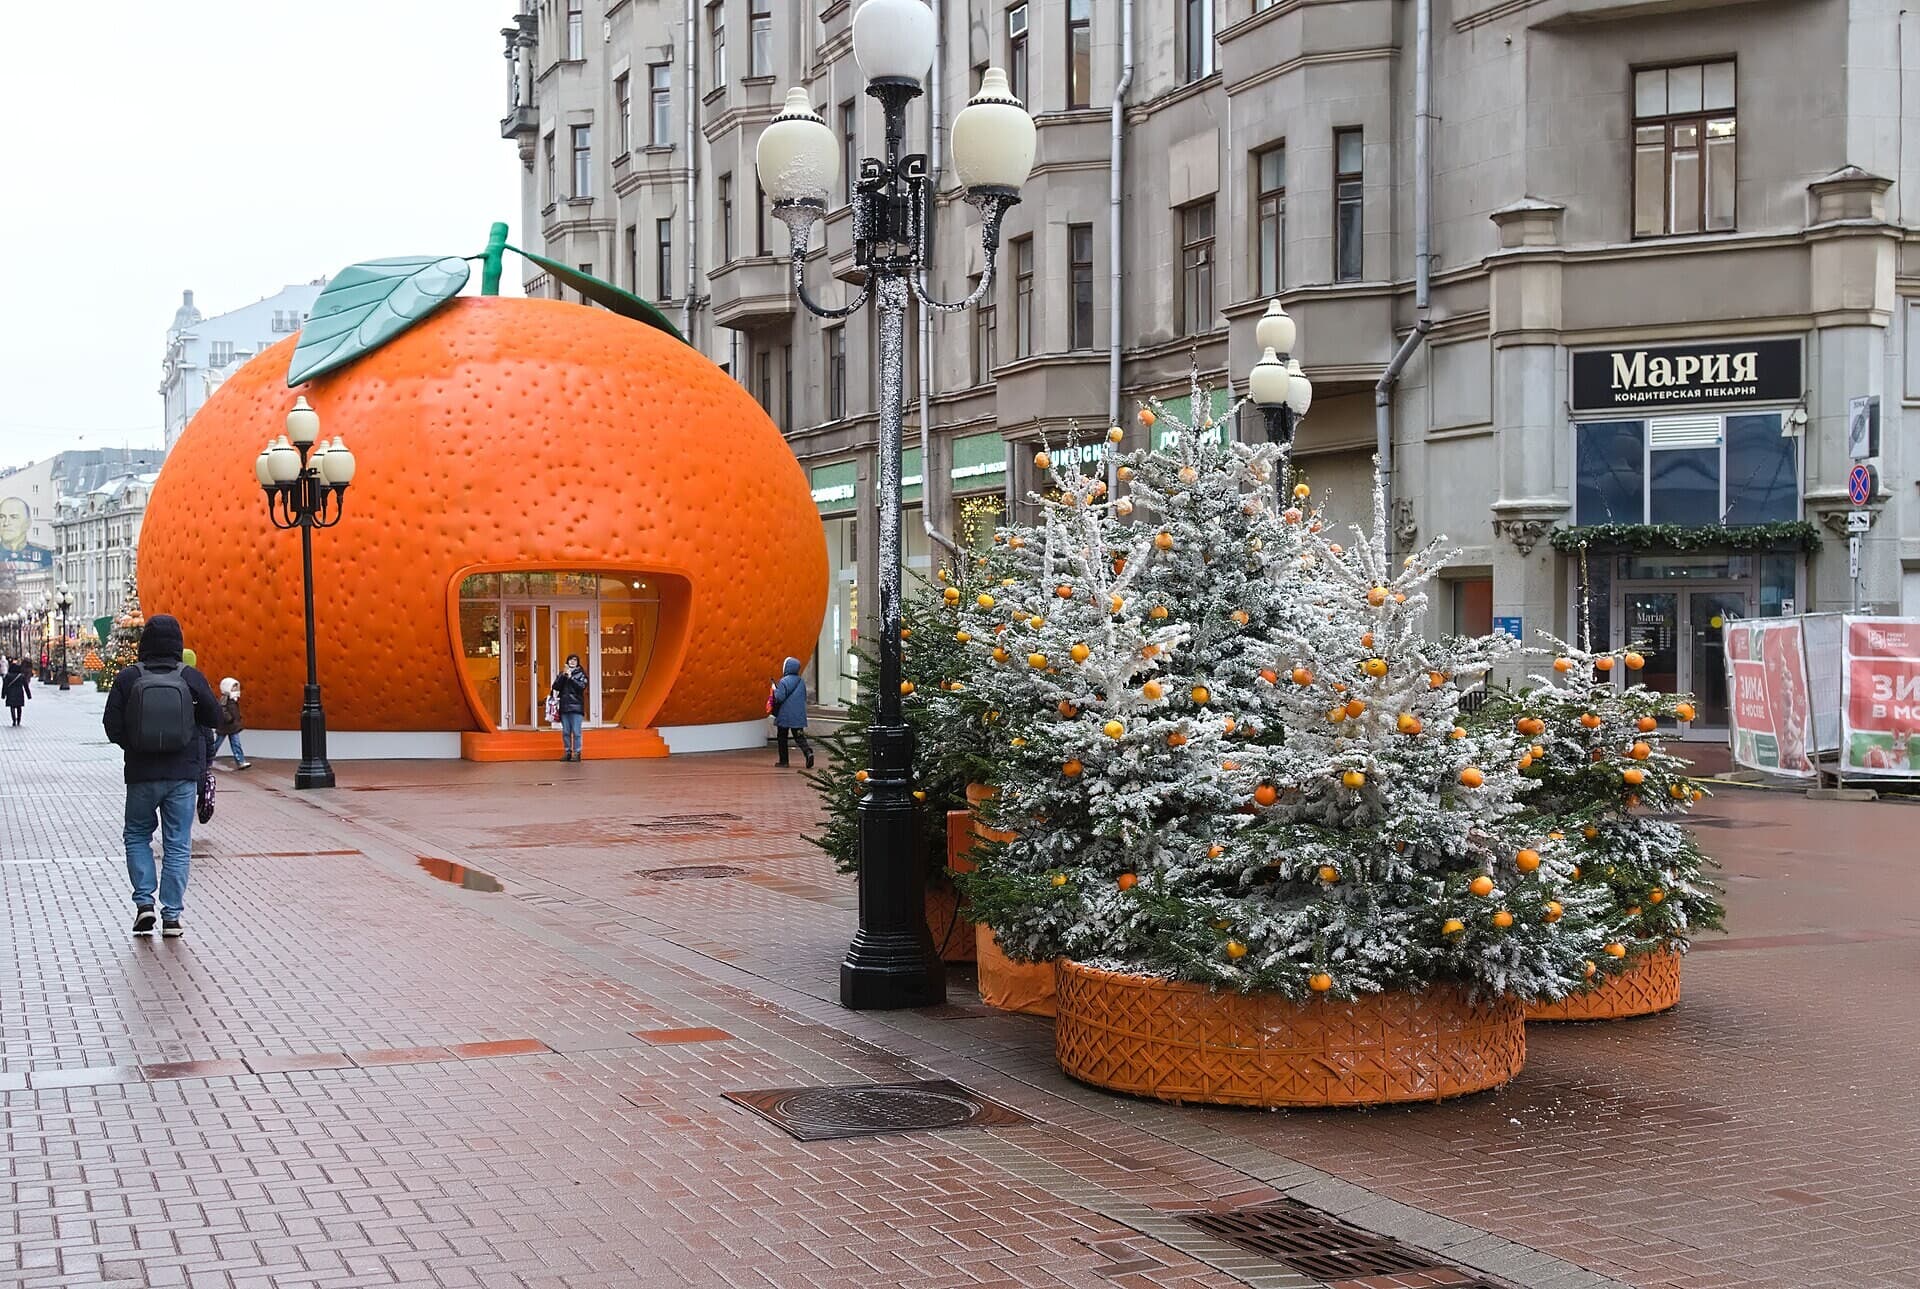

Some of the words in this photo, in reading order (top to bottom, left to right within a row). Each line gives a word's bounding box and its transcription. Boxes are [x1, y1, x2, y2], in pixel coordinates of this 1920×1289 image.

[1614, 388, 1701, 402] КОНДИТЕРСКАЯ
[1705, 386, 1757, 397] ПЕКАРНЯ
[1044, 443, 1108, 467] UNLIGH
[1740, 676, 1765, 702] ЗИМА
[1746, 703, 1765, 720] МОСКВЕ
[1872, 704, 1887, 718] В
